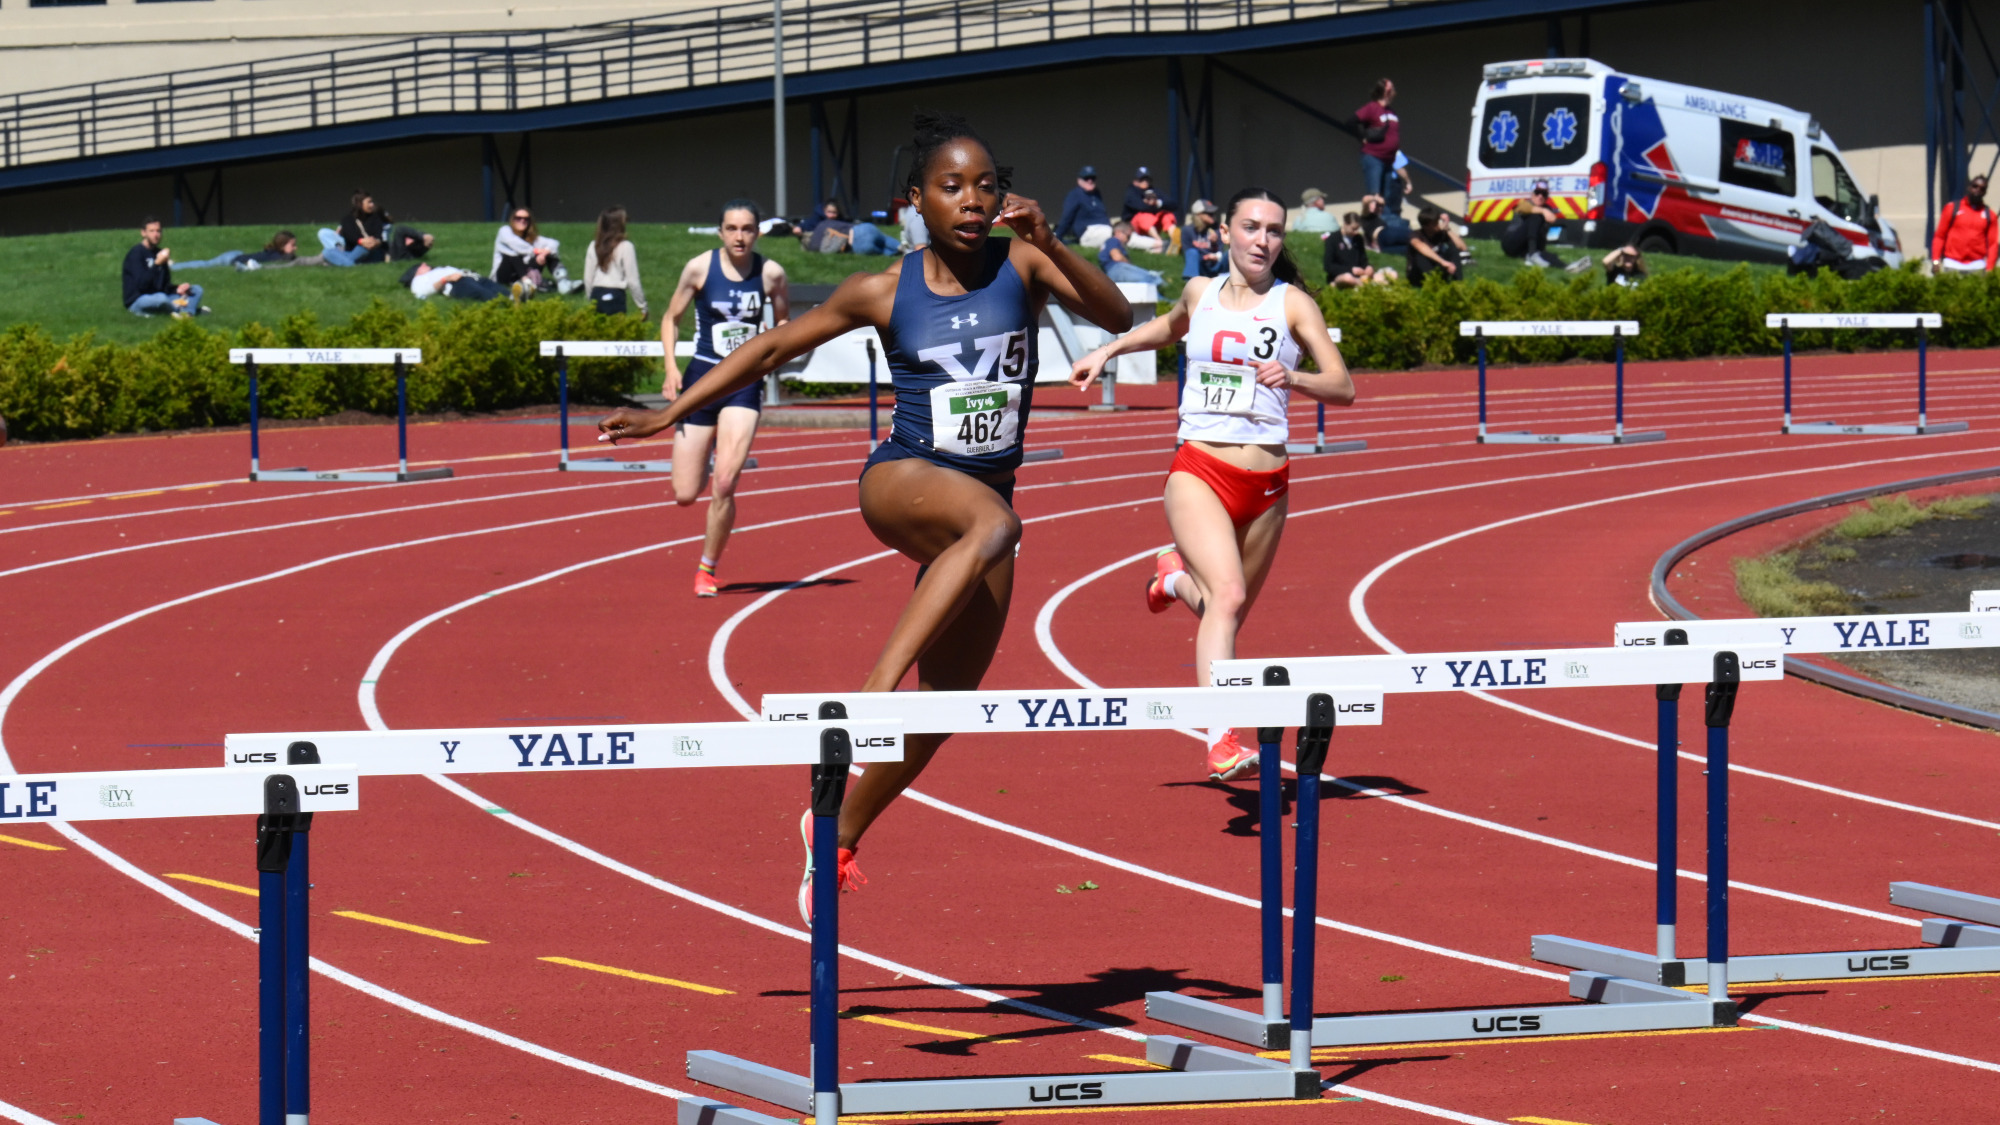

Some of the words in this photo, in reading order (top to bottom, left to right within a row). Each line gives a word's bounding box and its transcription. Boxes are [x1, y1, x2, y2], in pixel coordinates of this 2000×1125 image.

[1685, 94, 1747, 119] AMBULANCE
[1488, 178, 1563, 192] AMBULCE
[747, 294, 758, 315] 4
[1837, 317, 1868, 326] YALE
[1532, 325, 1562, 334] YALE
[1212, 330, 1246, 366] C
[1253, 326, 1277, 359] 3
[307, 351, 342, 362] YALE
[614, 345, 648, 355] YALE
[1002, 334, 1026, 377] 5
[917, 333, 1005, 383] Y
[966, 397, 984, 410] Ivy
[1203, 386, 1236, 411] 147
[957, 410, 1003, 445] 462
[1781, 627, 1797, 645] Y
[1834, 620, 1930, 648] YALE
[1623, 638, 1656, 647] UCS
[1570, 664, 1588, 674] IVY
[1742, 660, 1777, 669] UCS
[1411, 666, 1428, 684] Y
[1445, 658, 1547, 688] YALE
[1216, 677, 1253, 687] UCS
[981, 703, 999, 724] Y
[1018, 697, 1128, 728] YALE
[1153, 705, 1173, 715] IVY
[1338, 703, 1376, 713] UCS
[769, 713, 809, 722] UCS
[440, 740, 460, 763] Y
[509, 731, 635, 767] YALE
[680, 740, 703, 751] IVY
[855, 737, 896, 748] UCS
[233, 752, 277, 764] UCS
[108, 789, 133, 801] IVY
[304, 783, 349, 796] UCS
[0, 780, 57, 818] LE
[1847, 955, 1910, 972] UCS
[1473, 1014, 1541, 1033] UCS
[1029, 1081, 1104, 1102] UCS
